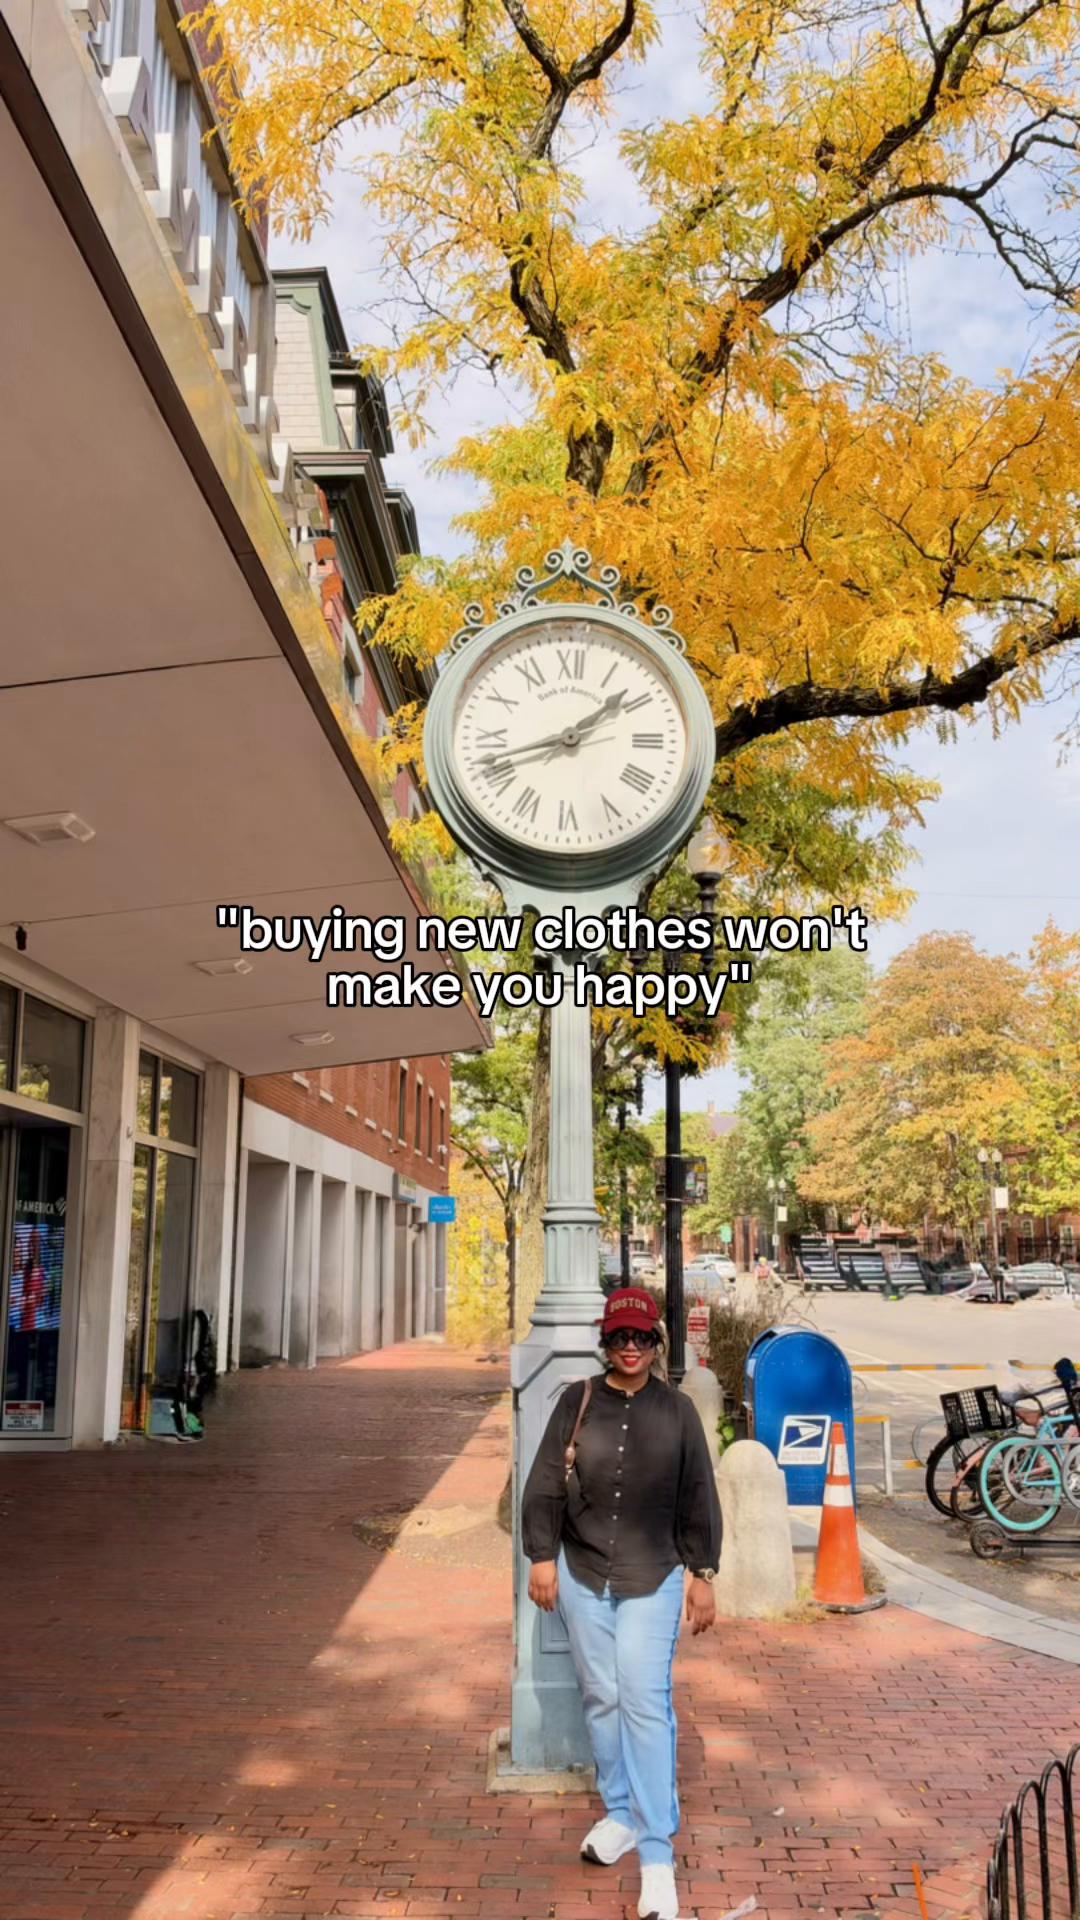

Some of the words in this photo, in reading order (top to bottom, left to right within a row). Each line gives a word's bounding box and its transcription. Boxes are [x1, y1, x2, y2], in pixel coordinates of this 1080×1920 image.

[514, 656, 546, 692] XI
[556, 649, 586, 681] XII
[601, 661, 619, 689] I
[486, 687, 519, 714] X
[537, 687, 558, 702] Bank
[560, 685, 570, 694] of
[570, 685, 603, 705] America
[475, 727, 508, 749] IX
[632, 733, 664, 749] III
[512, 786, 542, 824] VII
[558, 800, 579, 832] VI
[600, 794, 622, 823] V
[23, 1201, 54, 1214] AMERICA
[610, 1297, 648, 1313] BOSTON
